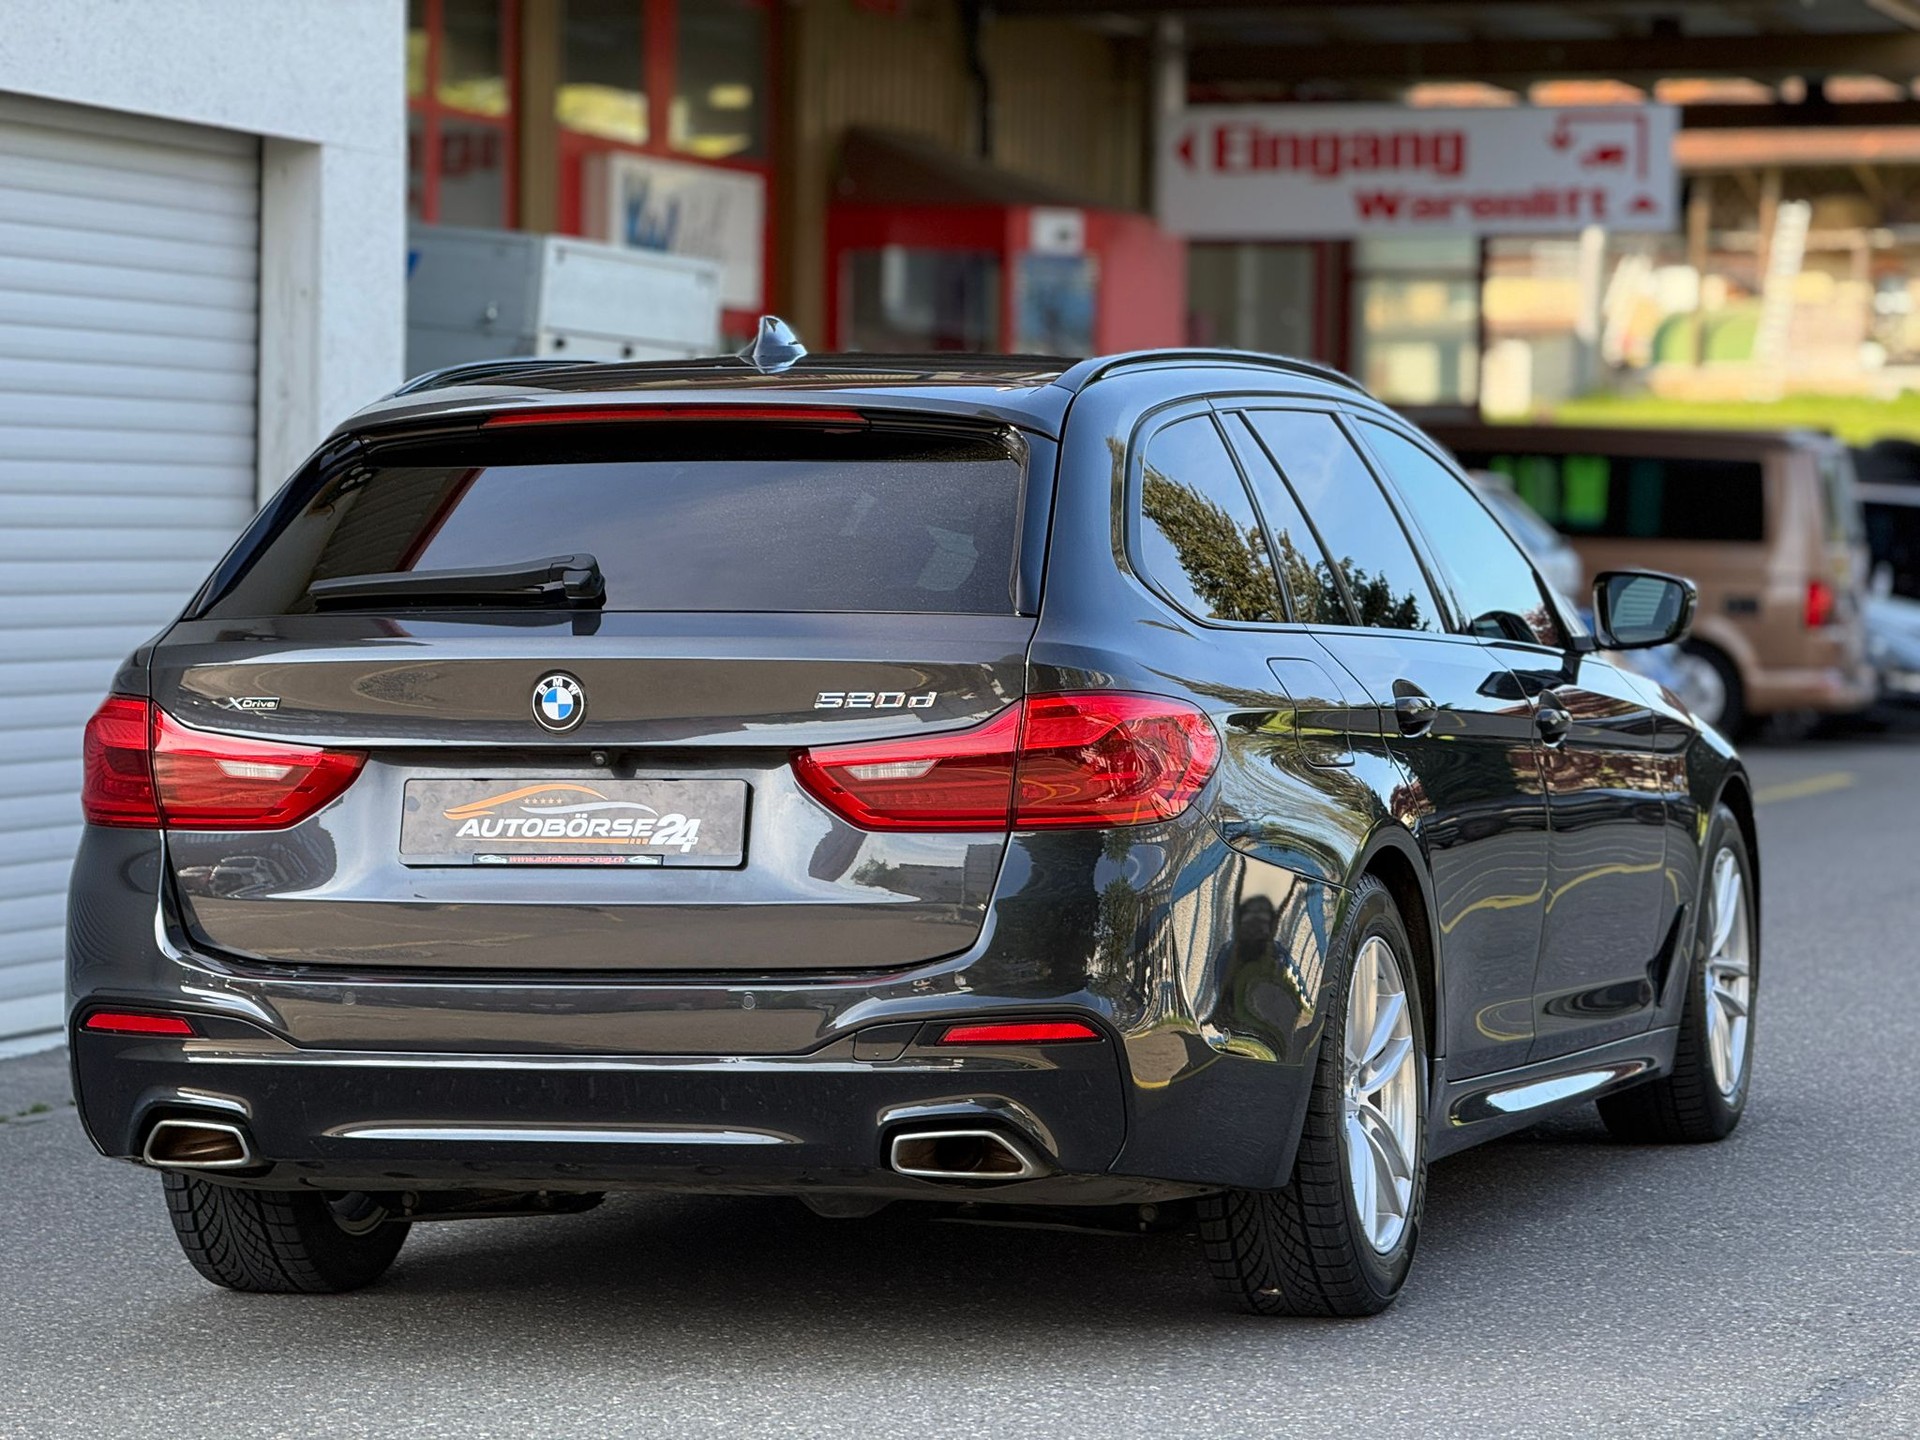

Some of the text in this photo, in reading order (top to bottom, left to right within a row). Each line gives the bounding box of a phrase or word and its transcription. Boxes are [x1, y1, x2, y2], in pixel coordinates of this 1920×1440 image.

[1212, 123, 1467, 180] Eingang
[1355, 189, 1606, 221] Warenlift
[537, 678, 580, 696] BMW
[814, 691, 938, 709] 520d
[509, 855, 626, 864] www.autoboerse-zug.ch
